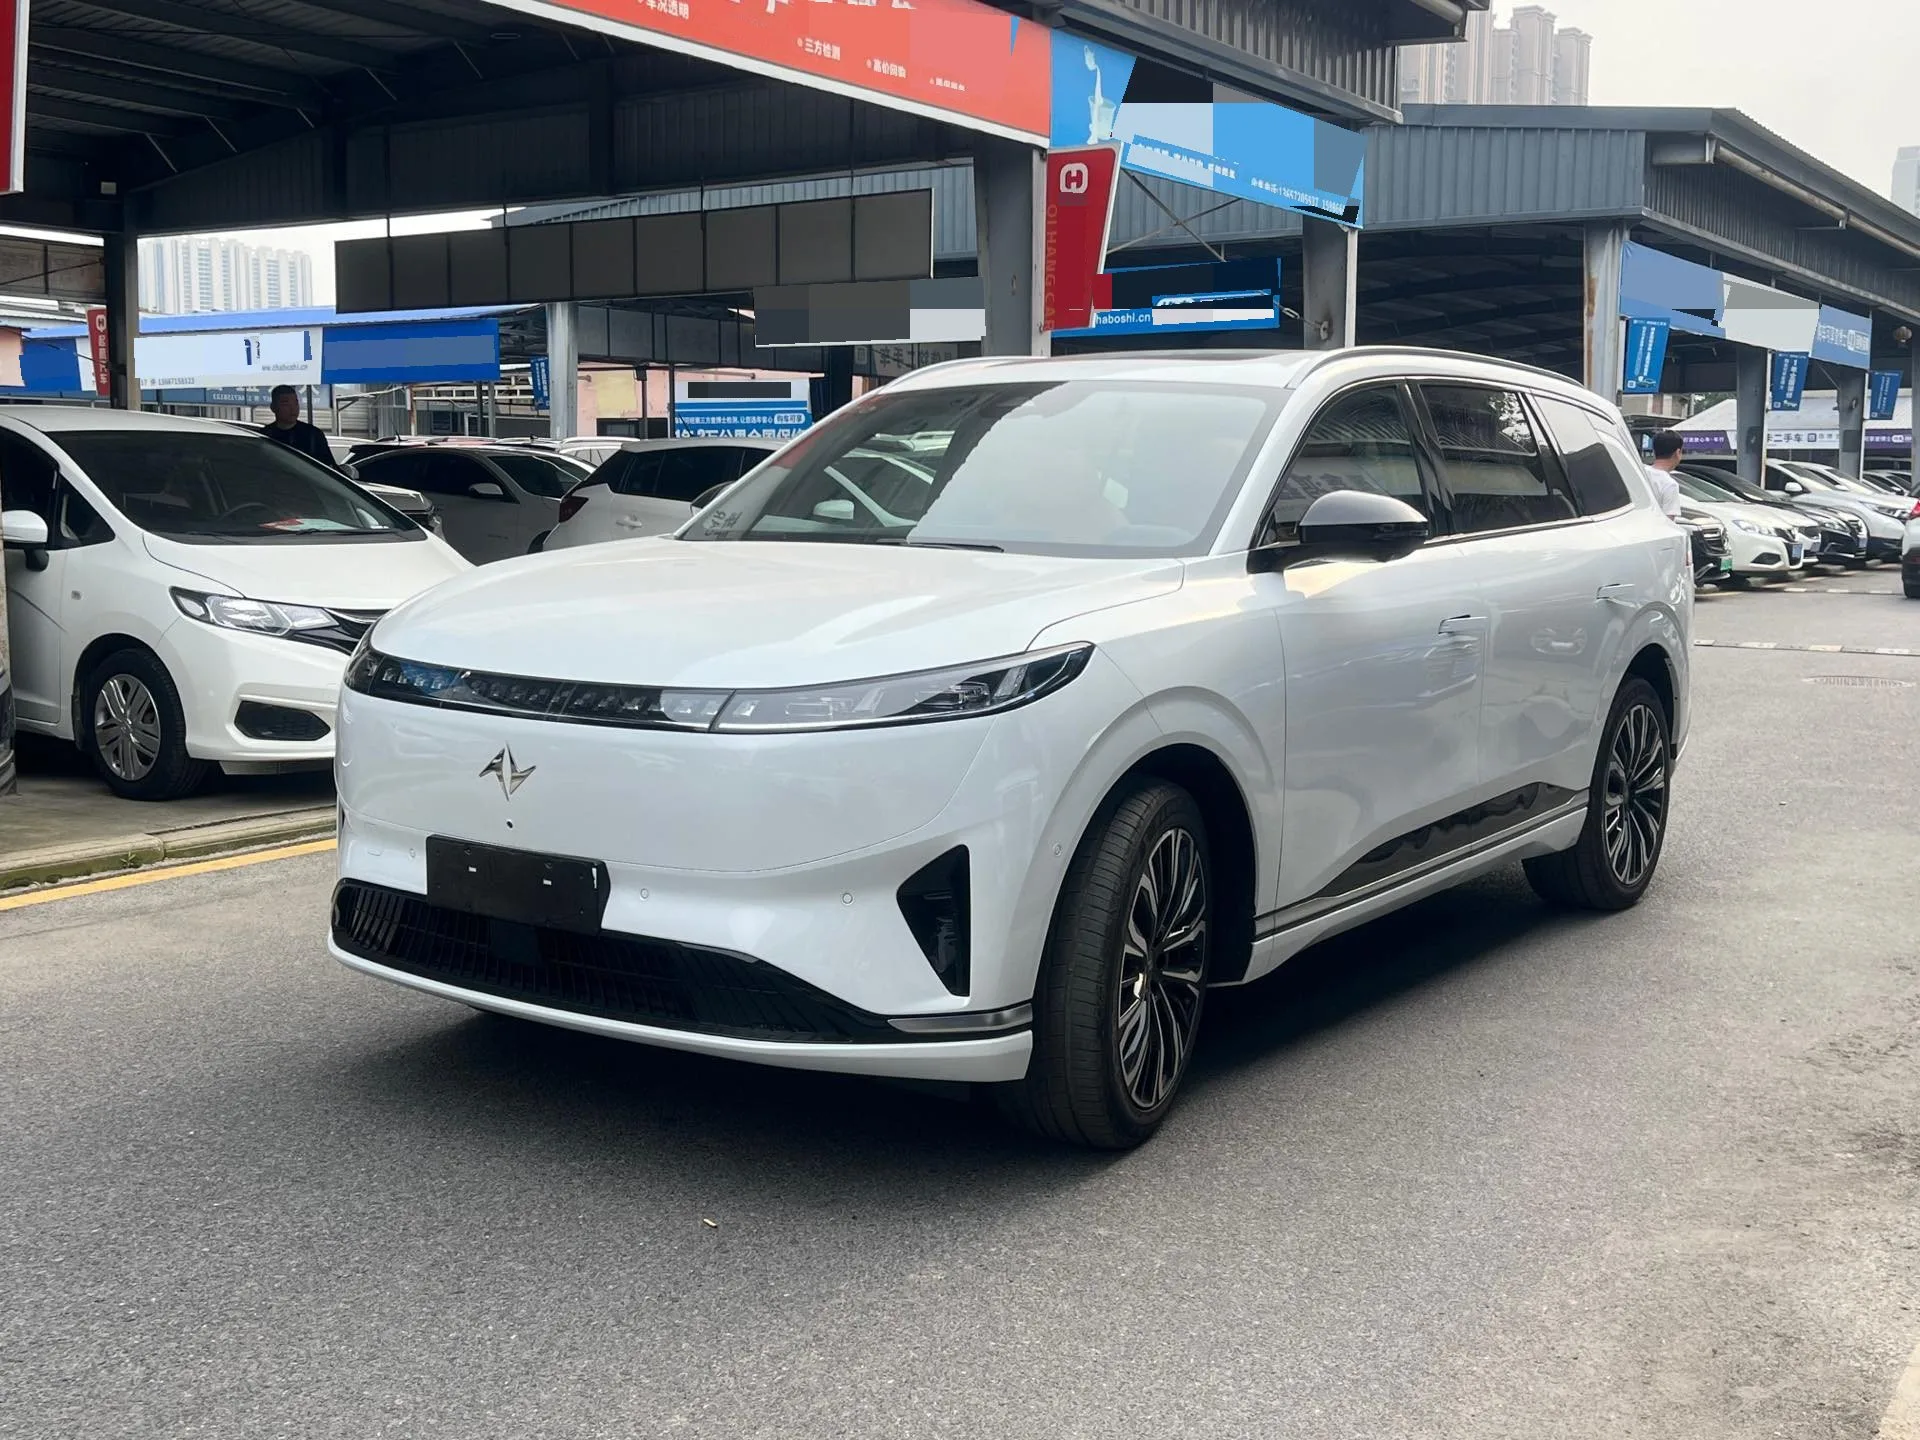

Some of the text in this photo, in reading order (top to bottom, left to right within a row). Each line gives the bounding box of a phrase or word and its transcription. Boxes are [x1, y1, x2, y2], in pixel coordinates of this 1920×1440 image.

[804, 38, 841, 61] 三方检测
[1046, 231, 1058, 286] HANG
